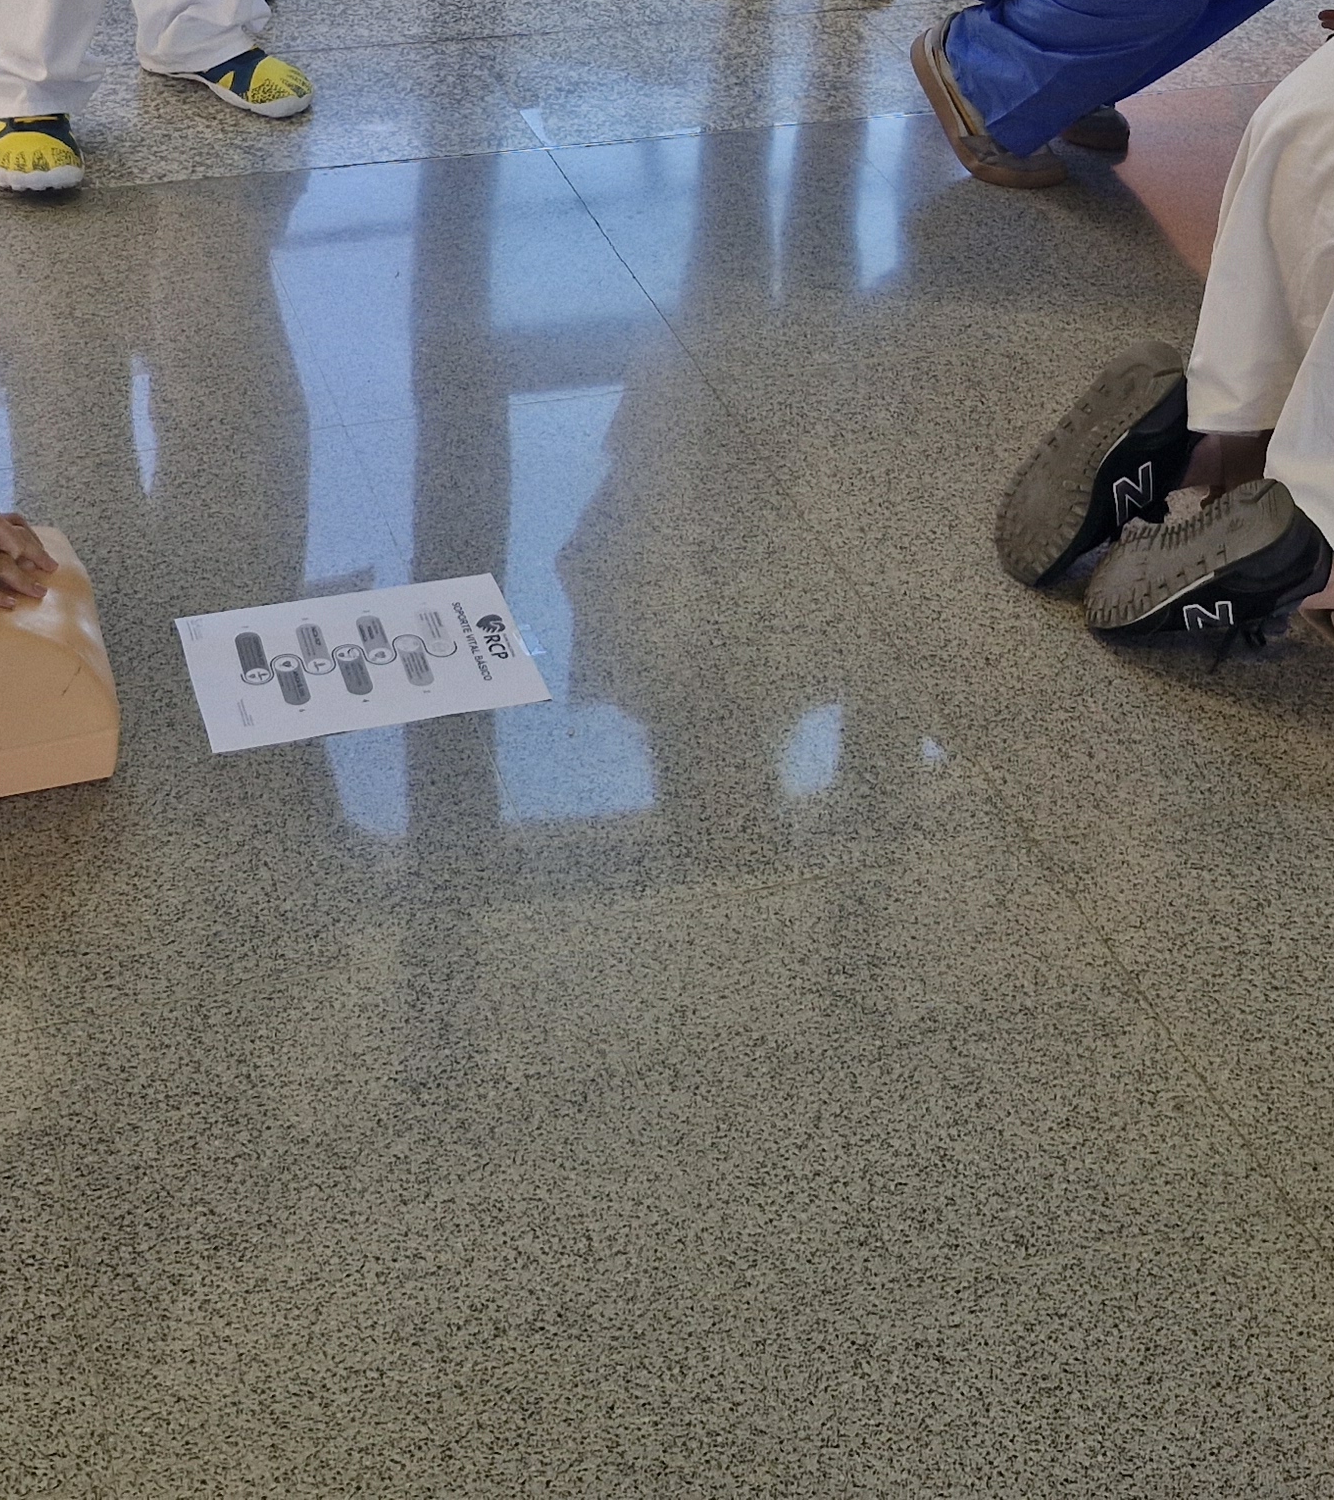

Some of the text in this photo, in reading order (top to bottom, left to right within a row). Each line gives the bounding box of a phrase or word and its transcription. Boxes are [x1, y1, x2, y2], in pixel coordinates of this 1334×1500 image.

[452, 602, 473, 633] SOPORTE
[466, 634, 480, 655] VITAL
[483, 634, 509, 659] RCP
